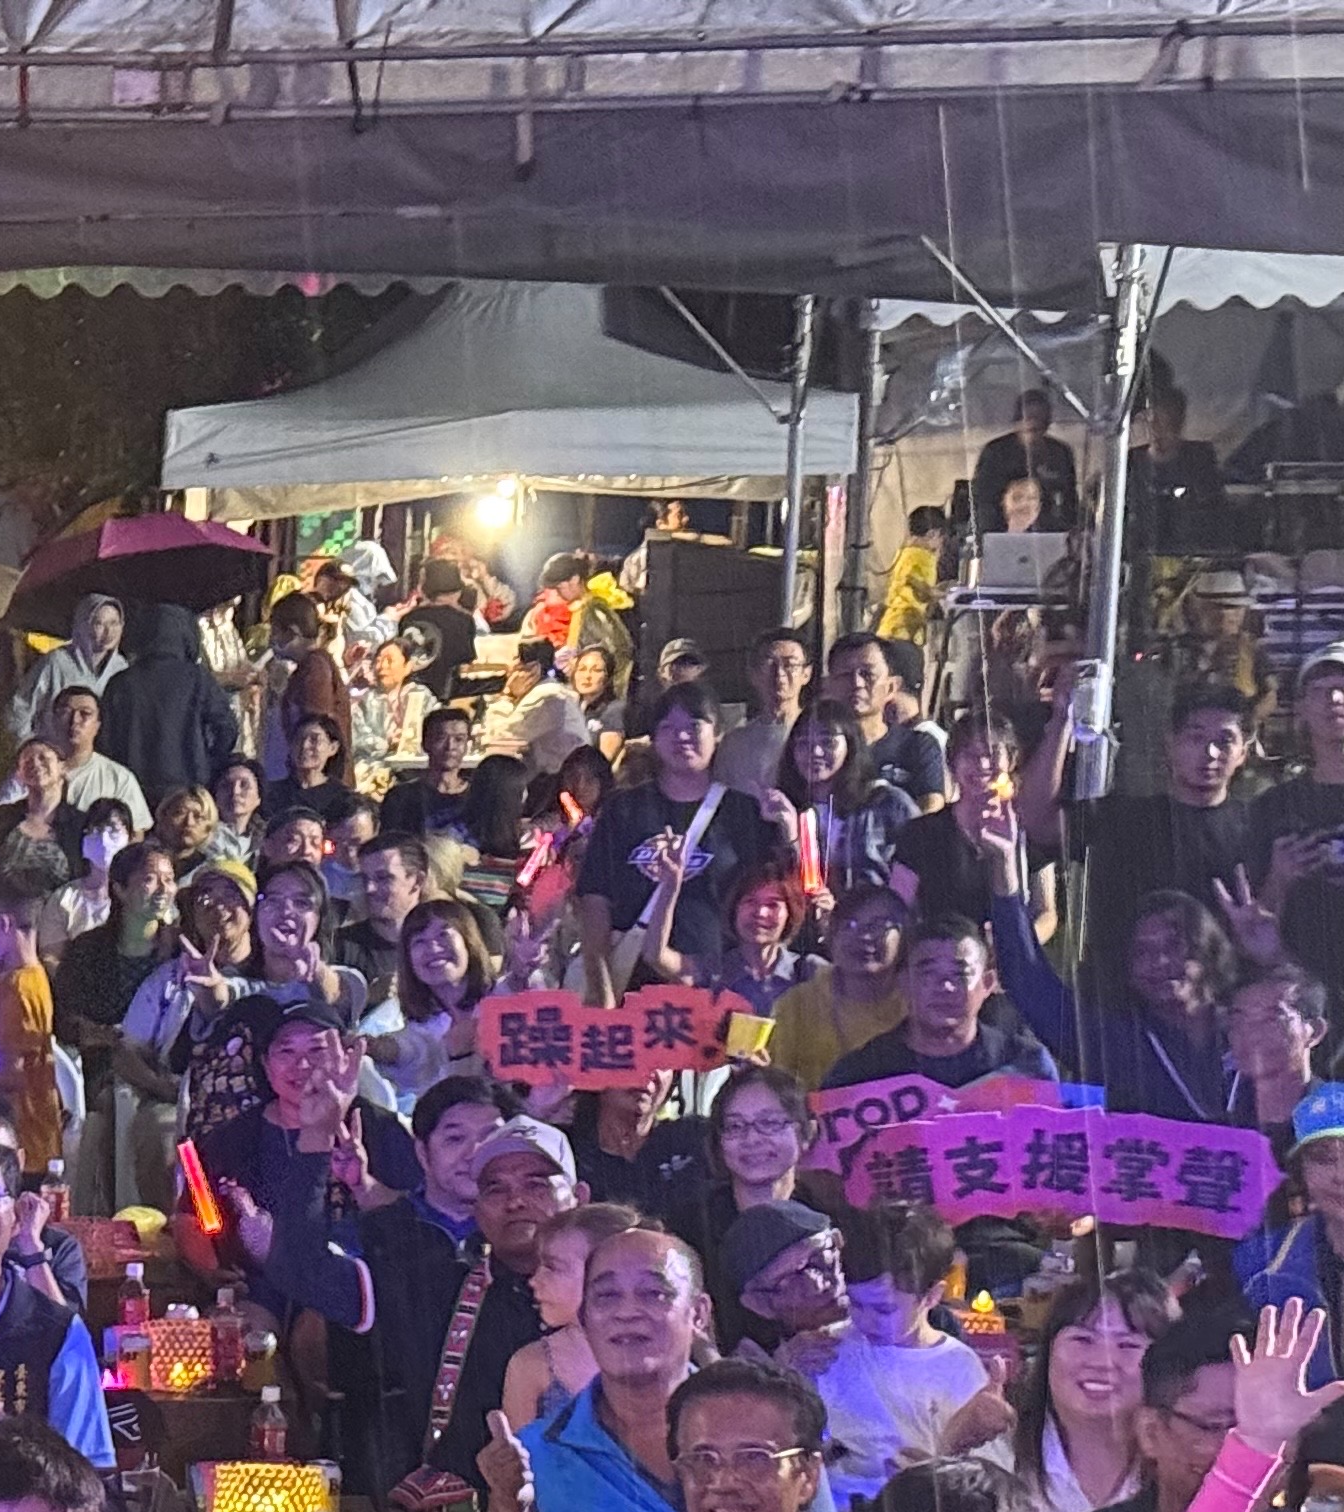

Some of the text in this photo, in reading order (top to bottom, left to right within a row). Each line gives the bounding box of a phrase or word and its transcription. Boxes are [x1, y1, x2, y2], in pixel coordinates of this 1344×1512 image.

[865, 1127, 1248, 1214] 請支援掌聲
